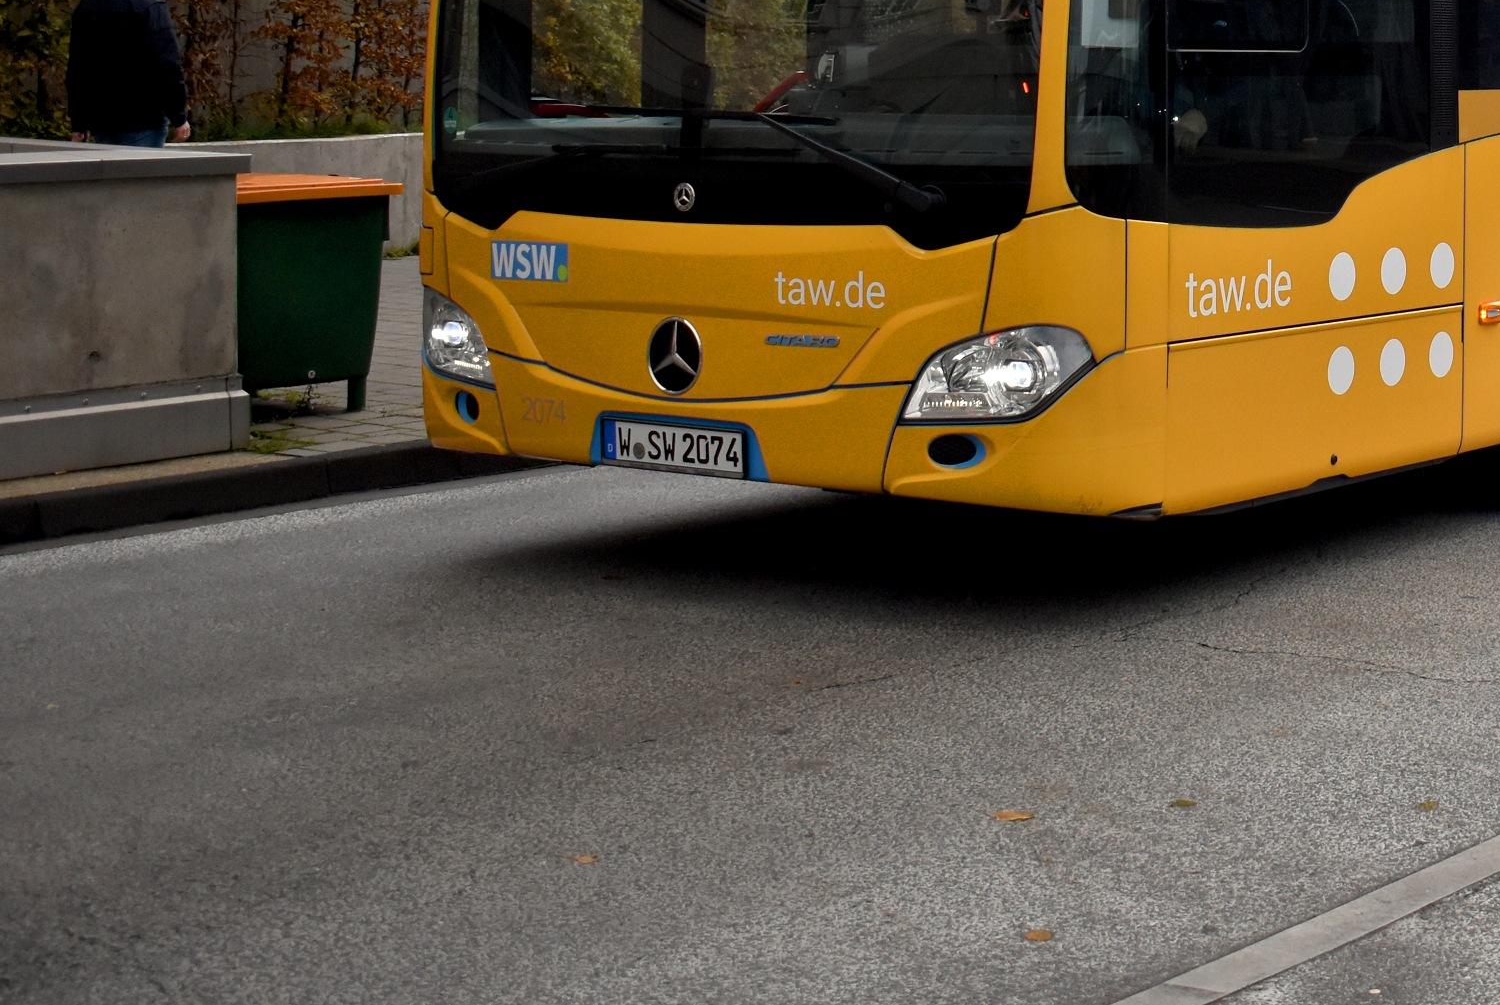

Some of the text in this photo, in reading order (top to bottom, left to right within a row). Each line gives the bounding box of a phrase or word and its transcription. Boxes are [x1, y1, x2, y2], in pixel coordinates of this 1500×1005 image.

[775, 270, 886, 308] taw.de
[1185, 259, 1292, 318] taw.de
[522, 395, 567, 424] 2074
[618, 426, 631, 457] W
[682, 433, 739, 467] 2074
